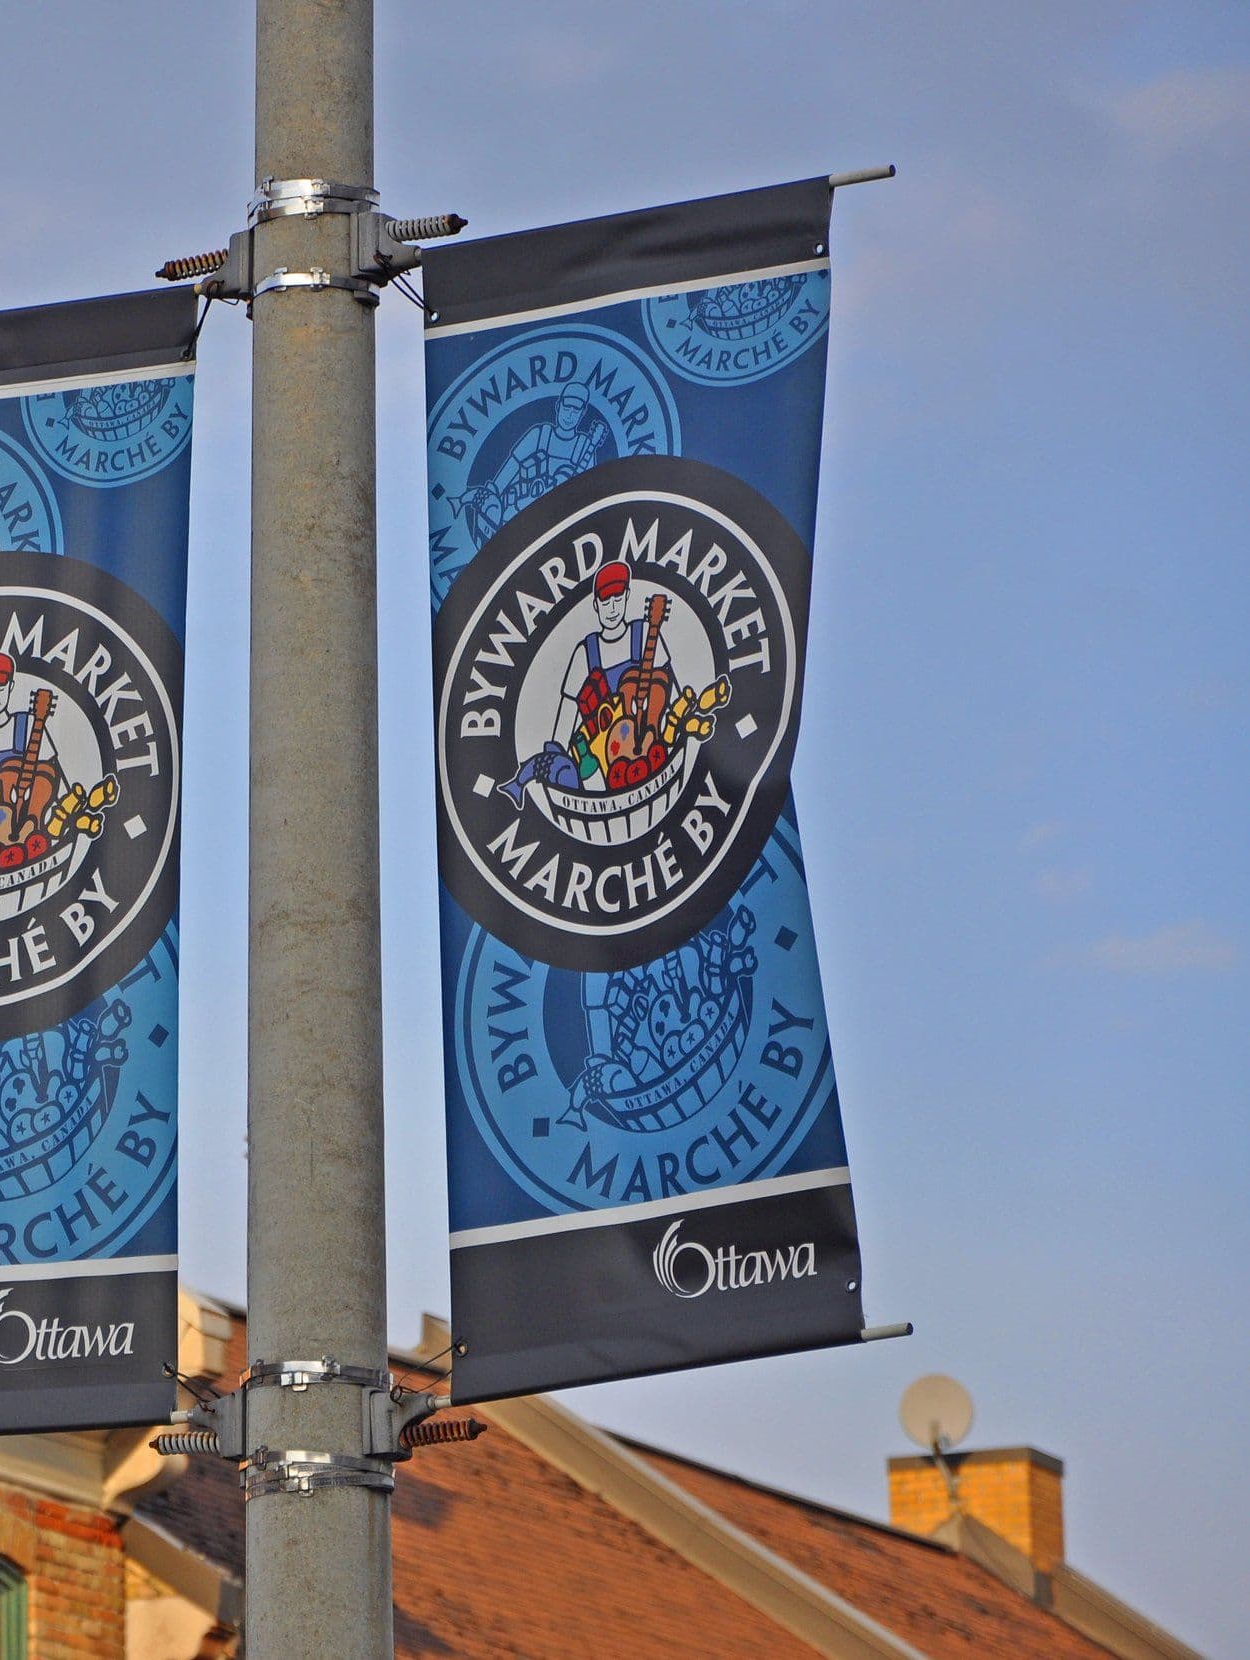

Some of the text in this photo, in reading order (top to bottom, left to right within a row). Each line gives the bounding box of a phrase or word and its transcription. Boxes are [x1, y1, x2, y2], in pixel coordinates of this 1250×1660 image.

[675, 328, 789, 372] MARCHÉ
[788, 299, 821, 336] BY
[55, 431, 162, 473] MARCHÉ
[160, 402, 189, 441] BY
[436, 350, 658, 462] BYWARD MARK
[460, 517, 771, 739] BYWARD MARKET
[0, 611, 160, 777] MARKET
[562, 764, 676, 813] OTTAWA, CANADA
[486, 818, 684, 914] MARCHÉ
[680, 770, 732, 857] BY
[59, 868, 120, 947] BY
[487, 953, 538, 1095] BYW
[115, 1090, 172, 1170] BY
[566, 997, 815, 1202] MARCHÉ BY
[652, 1218, 818, 1299] Ottawa
